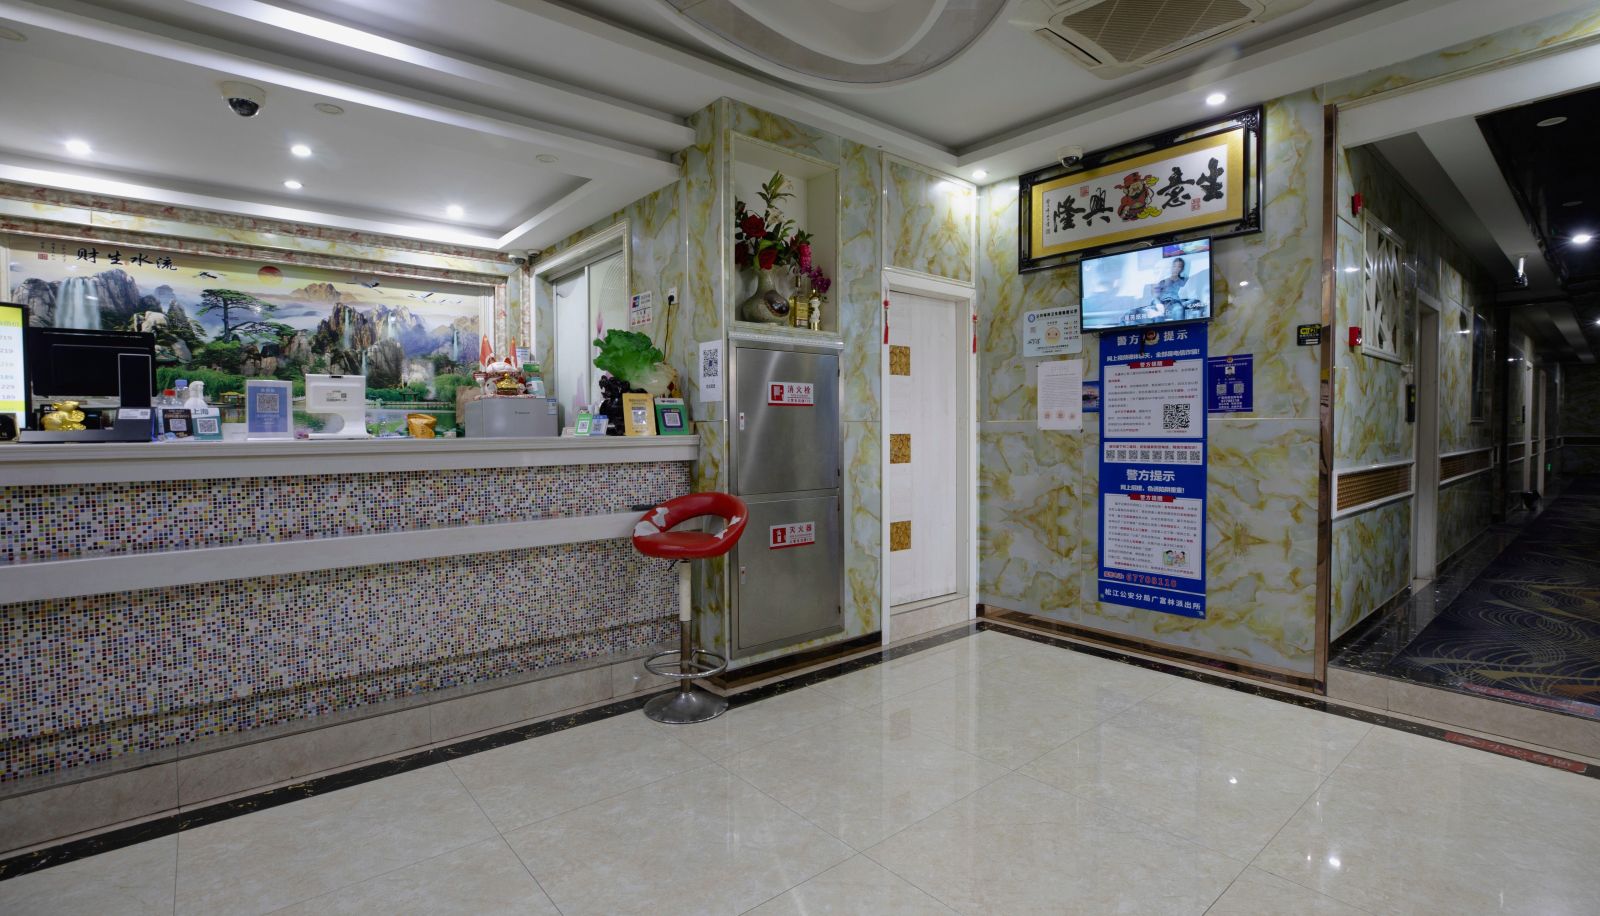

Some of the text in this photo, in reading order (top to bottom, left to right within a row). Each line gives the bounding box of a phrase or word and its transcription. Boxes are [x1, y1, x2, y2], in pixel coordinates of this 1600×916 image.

[77, 247, 178, 271] 流水生财
[787, 384, 811, 394] 消火栓
[1126, 468, 1176, 482] 警方提示
[790, 523, 812, 534] 灭火器
[1104, 587, 1201, 611] 松江公安分局广富林派出所
